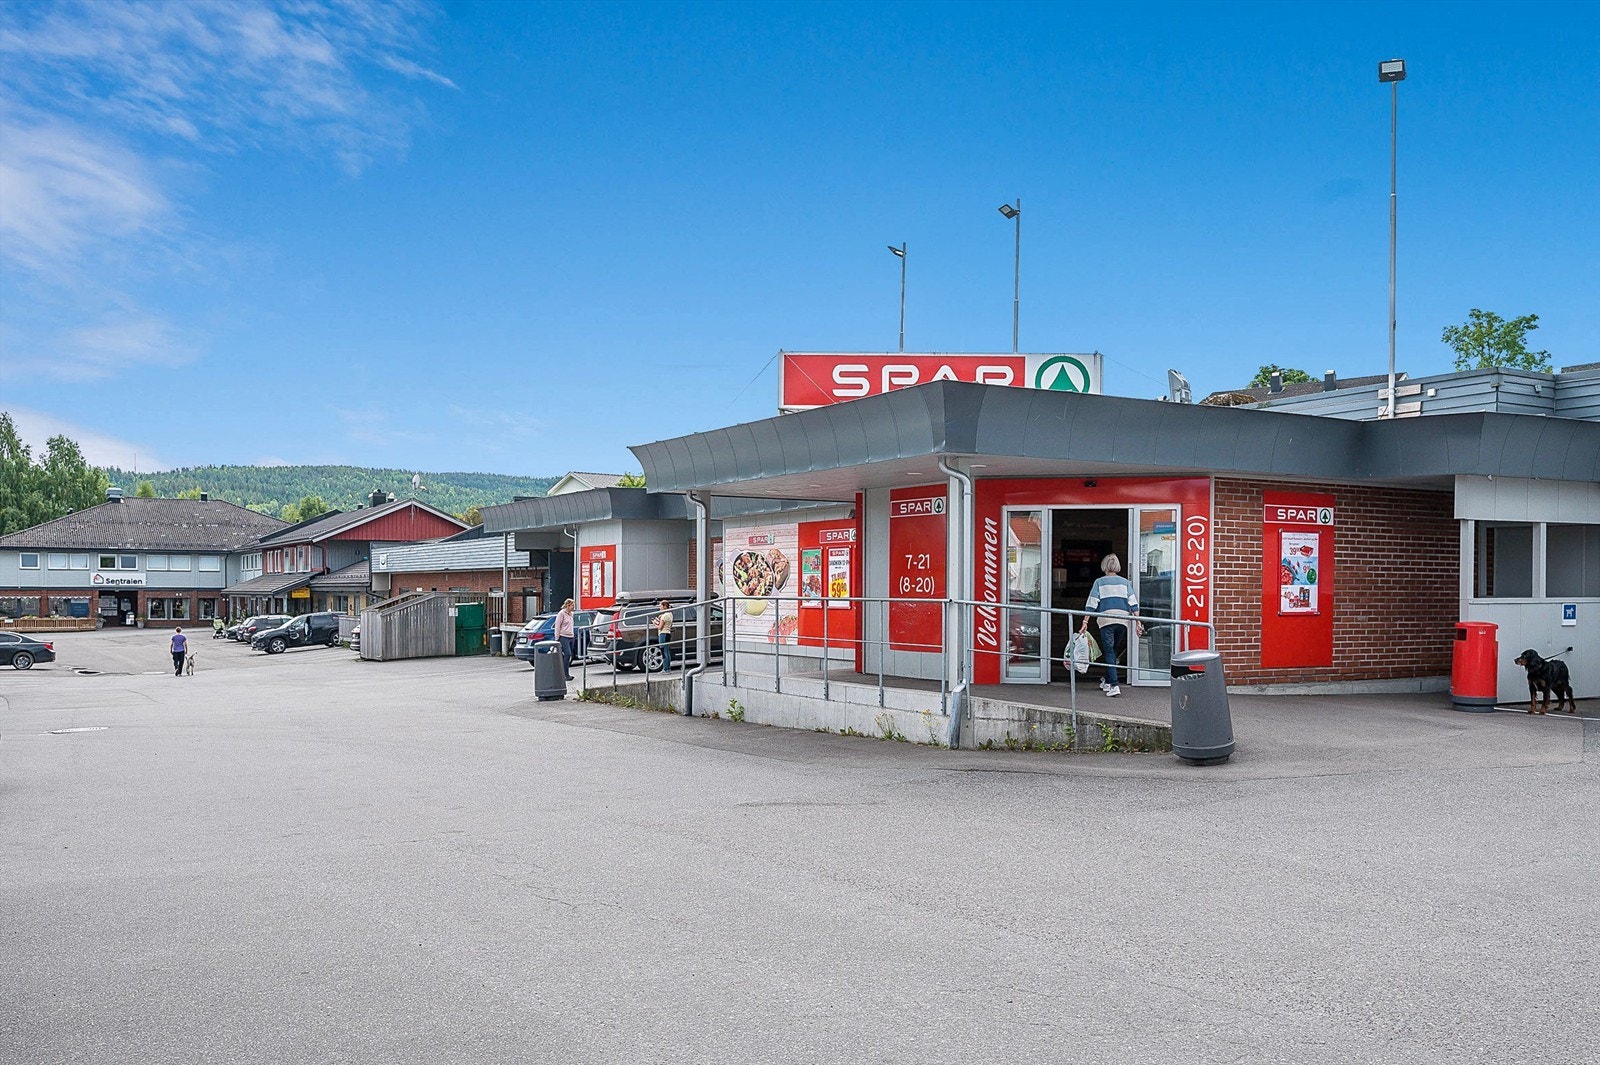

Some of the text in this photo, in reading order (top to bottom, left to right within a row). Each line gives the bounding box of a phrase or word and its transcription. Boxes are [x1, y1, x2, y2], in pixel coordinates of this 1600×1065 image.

[899, 502, 931, 514] SPAR
[1277, 508, 1316, 520] SPAR
[826, 531, 850, 541] SPAR
[905, 554, 930, 570] 7-21
[899, 576, 935, 595] (8-20)
[977, 516, 998, 647] Velkommen
